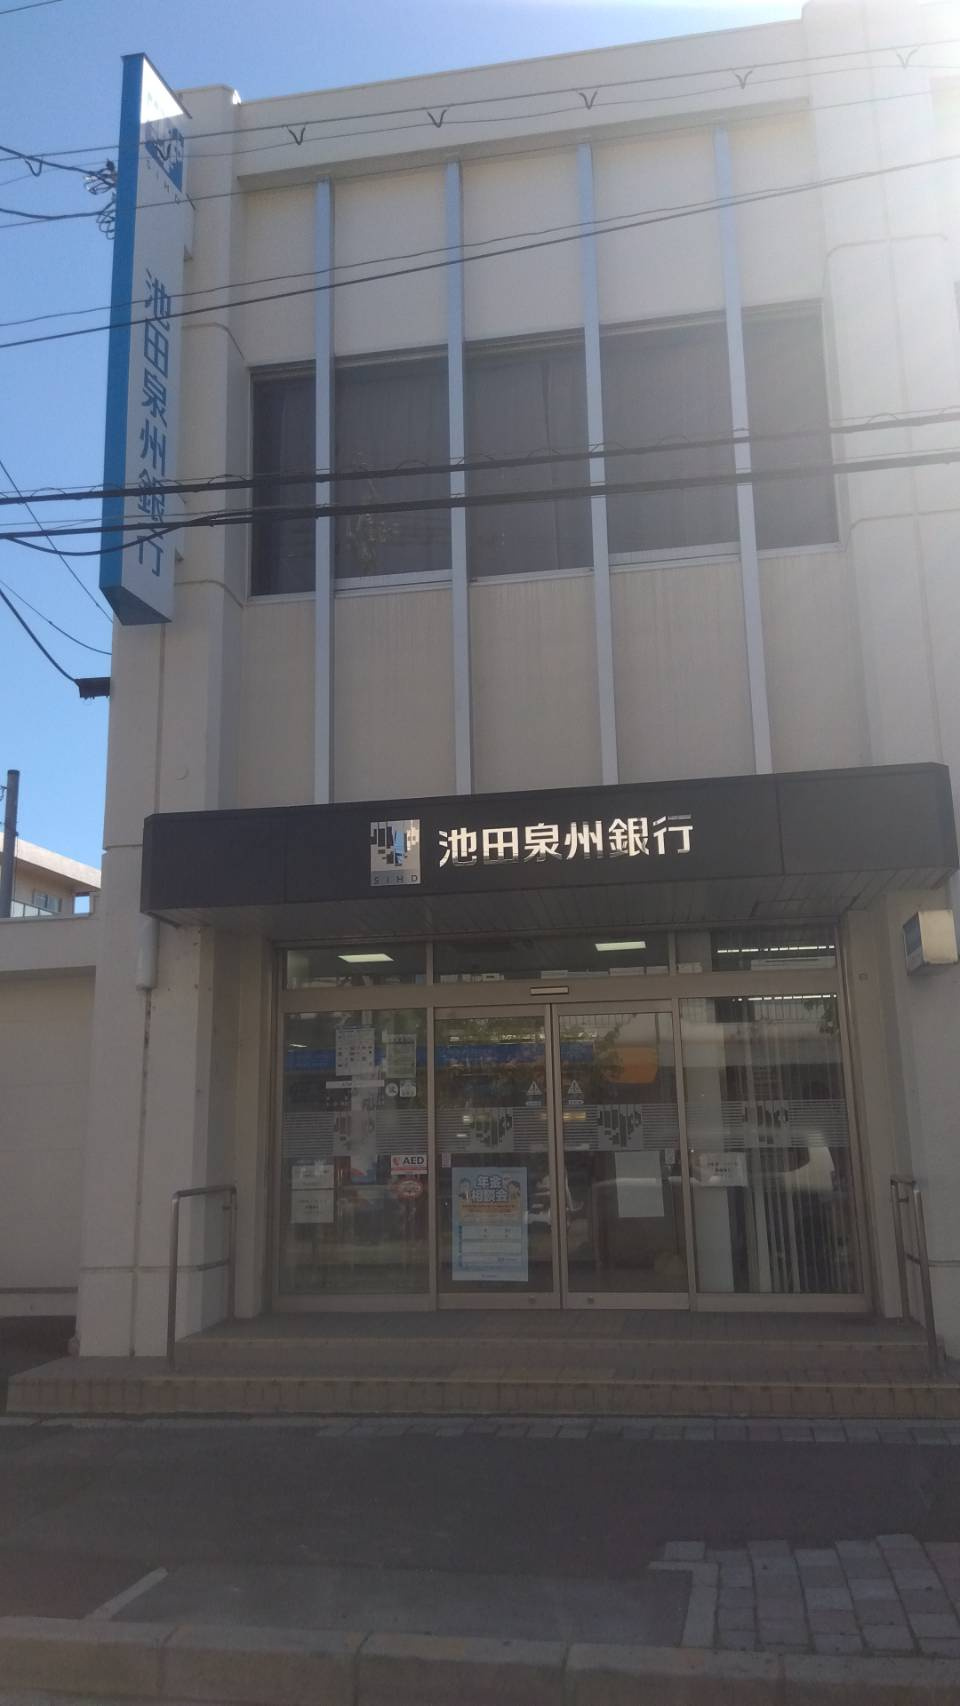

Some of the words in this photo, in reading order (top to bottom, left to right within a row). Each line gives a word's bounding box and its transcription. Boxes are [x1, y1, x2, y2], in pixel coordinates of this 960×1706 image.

[138, 267, 171, 577] 池田泉州銀行
[438, 814, 693, 868] 池田泉州銀行
[373, 874, 419, 885] SIHD
[403, 1156, 425, 1165] AED
[474, 1175, 503, 1189] 年金
